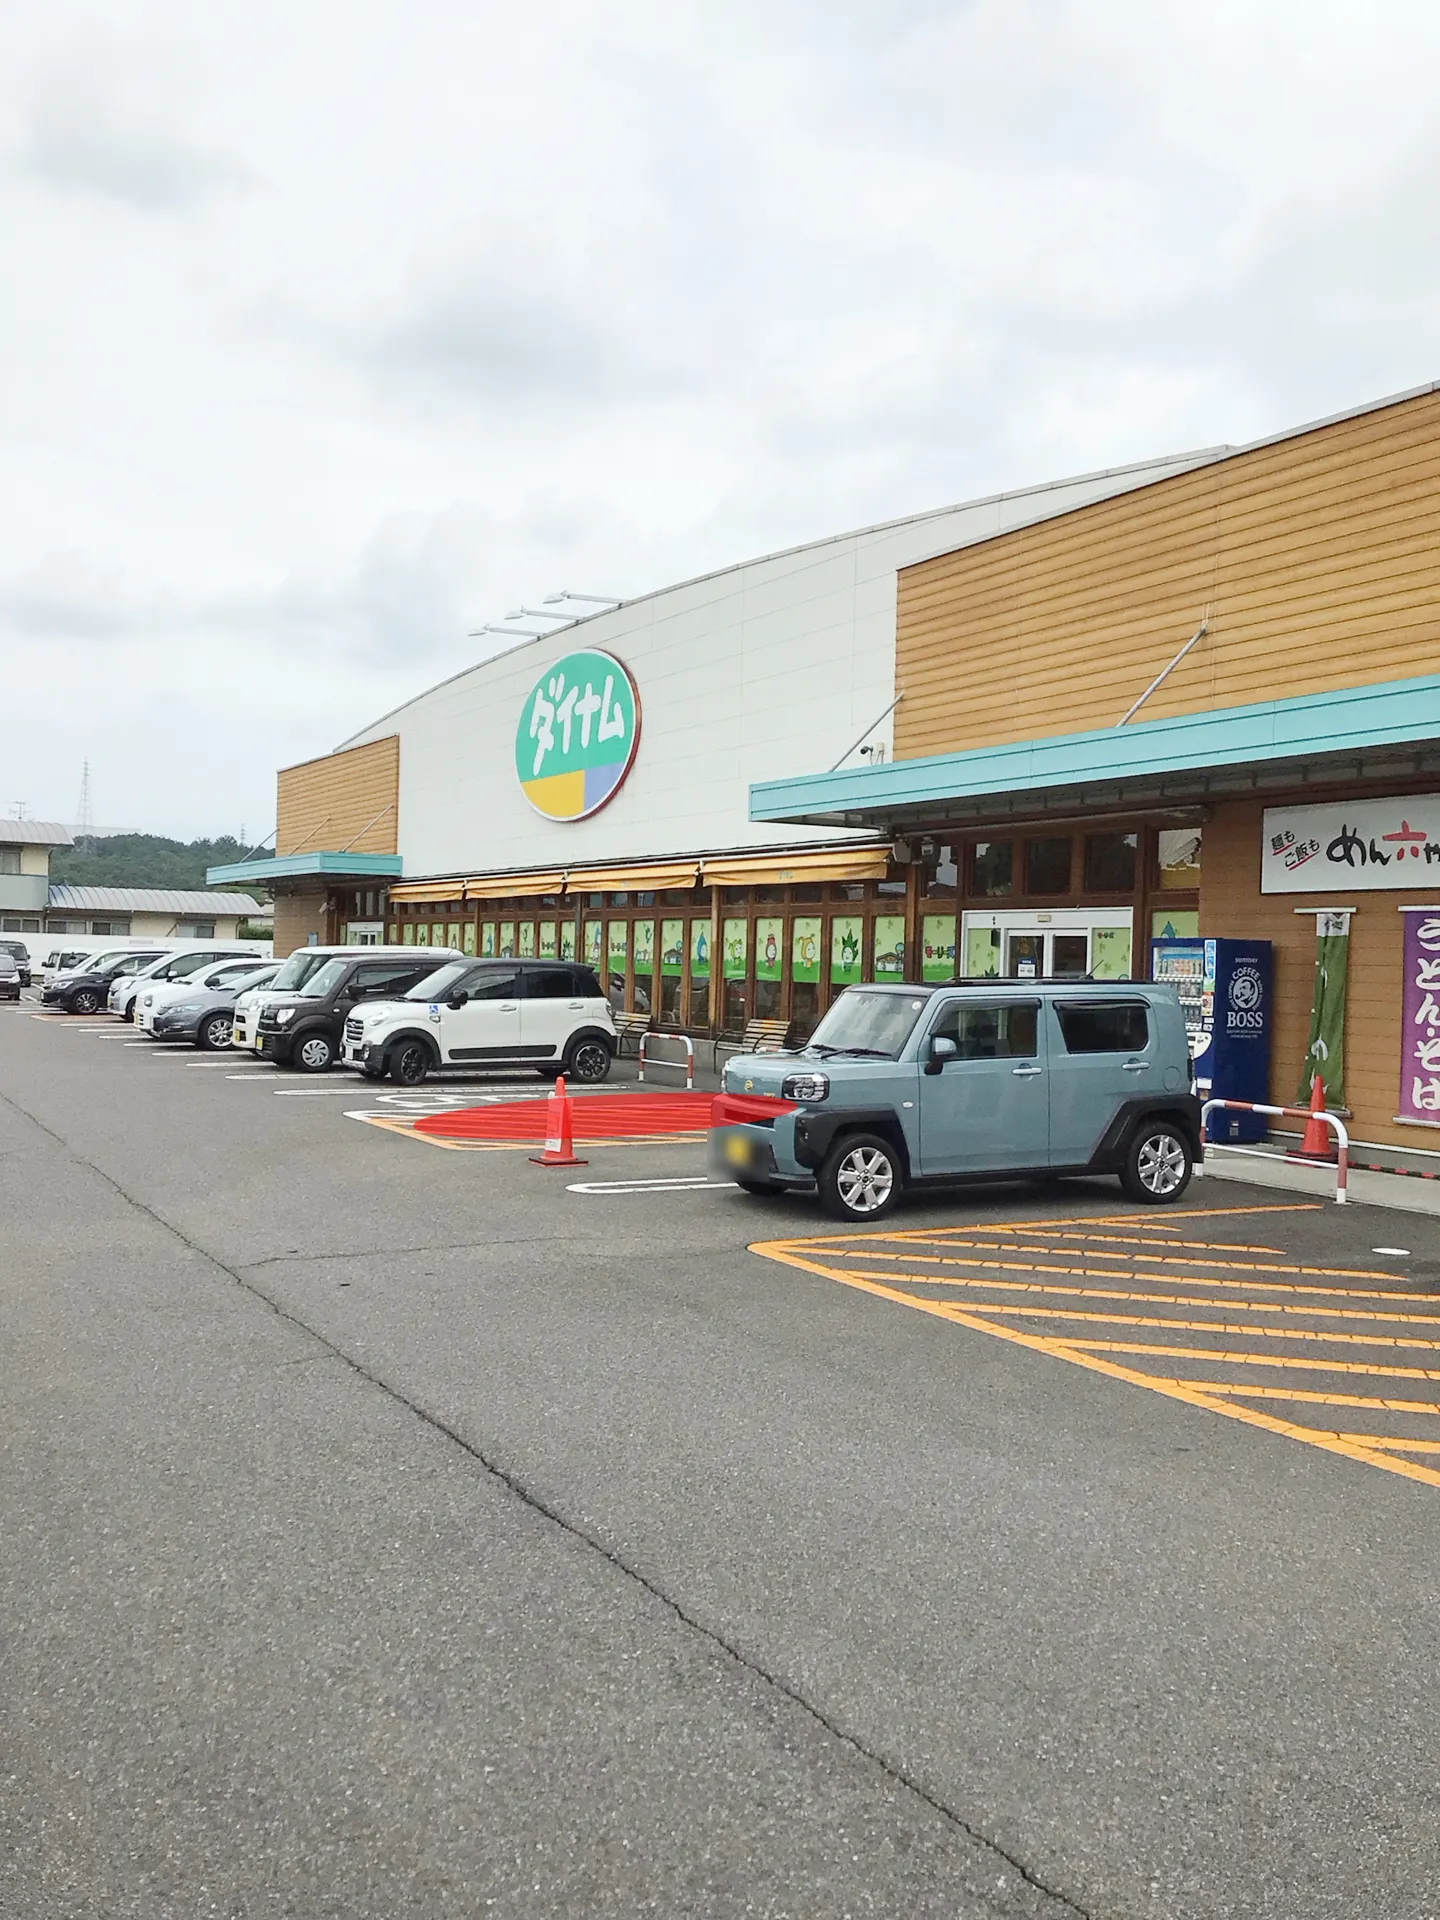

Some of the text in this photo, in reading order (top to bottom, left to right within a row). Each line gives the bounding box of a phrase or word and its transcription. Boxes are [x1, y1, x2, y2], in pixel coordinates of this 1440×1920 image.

[1284, 838, 1320, 868] ご飯も
[1232, 966, 1260, 981] COFFEE
[1227, 1011, 1264, 1028] BOSS
